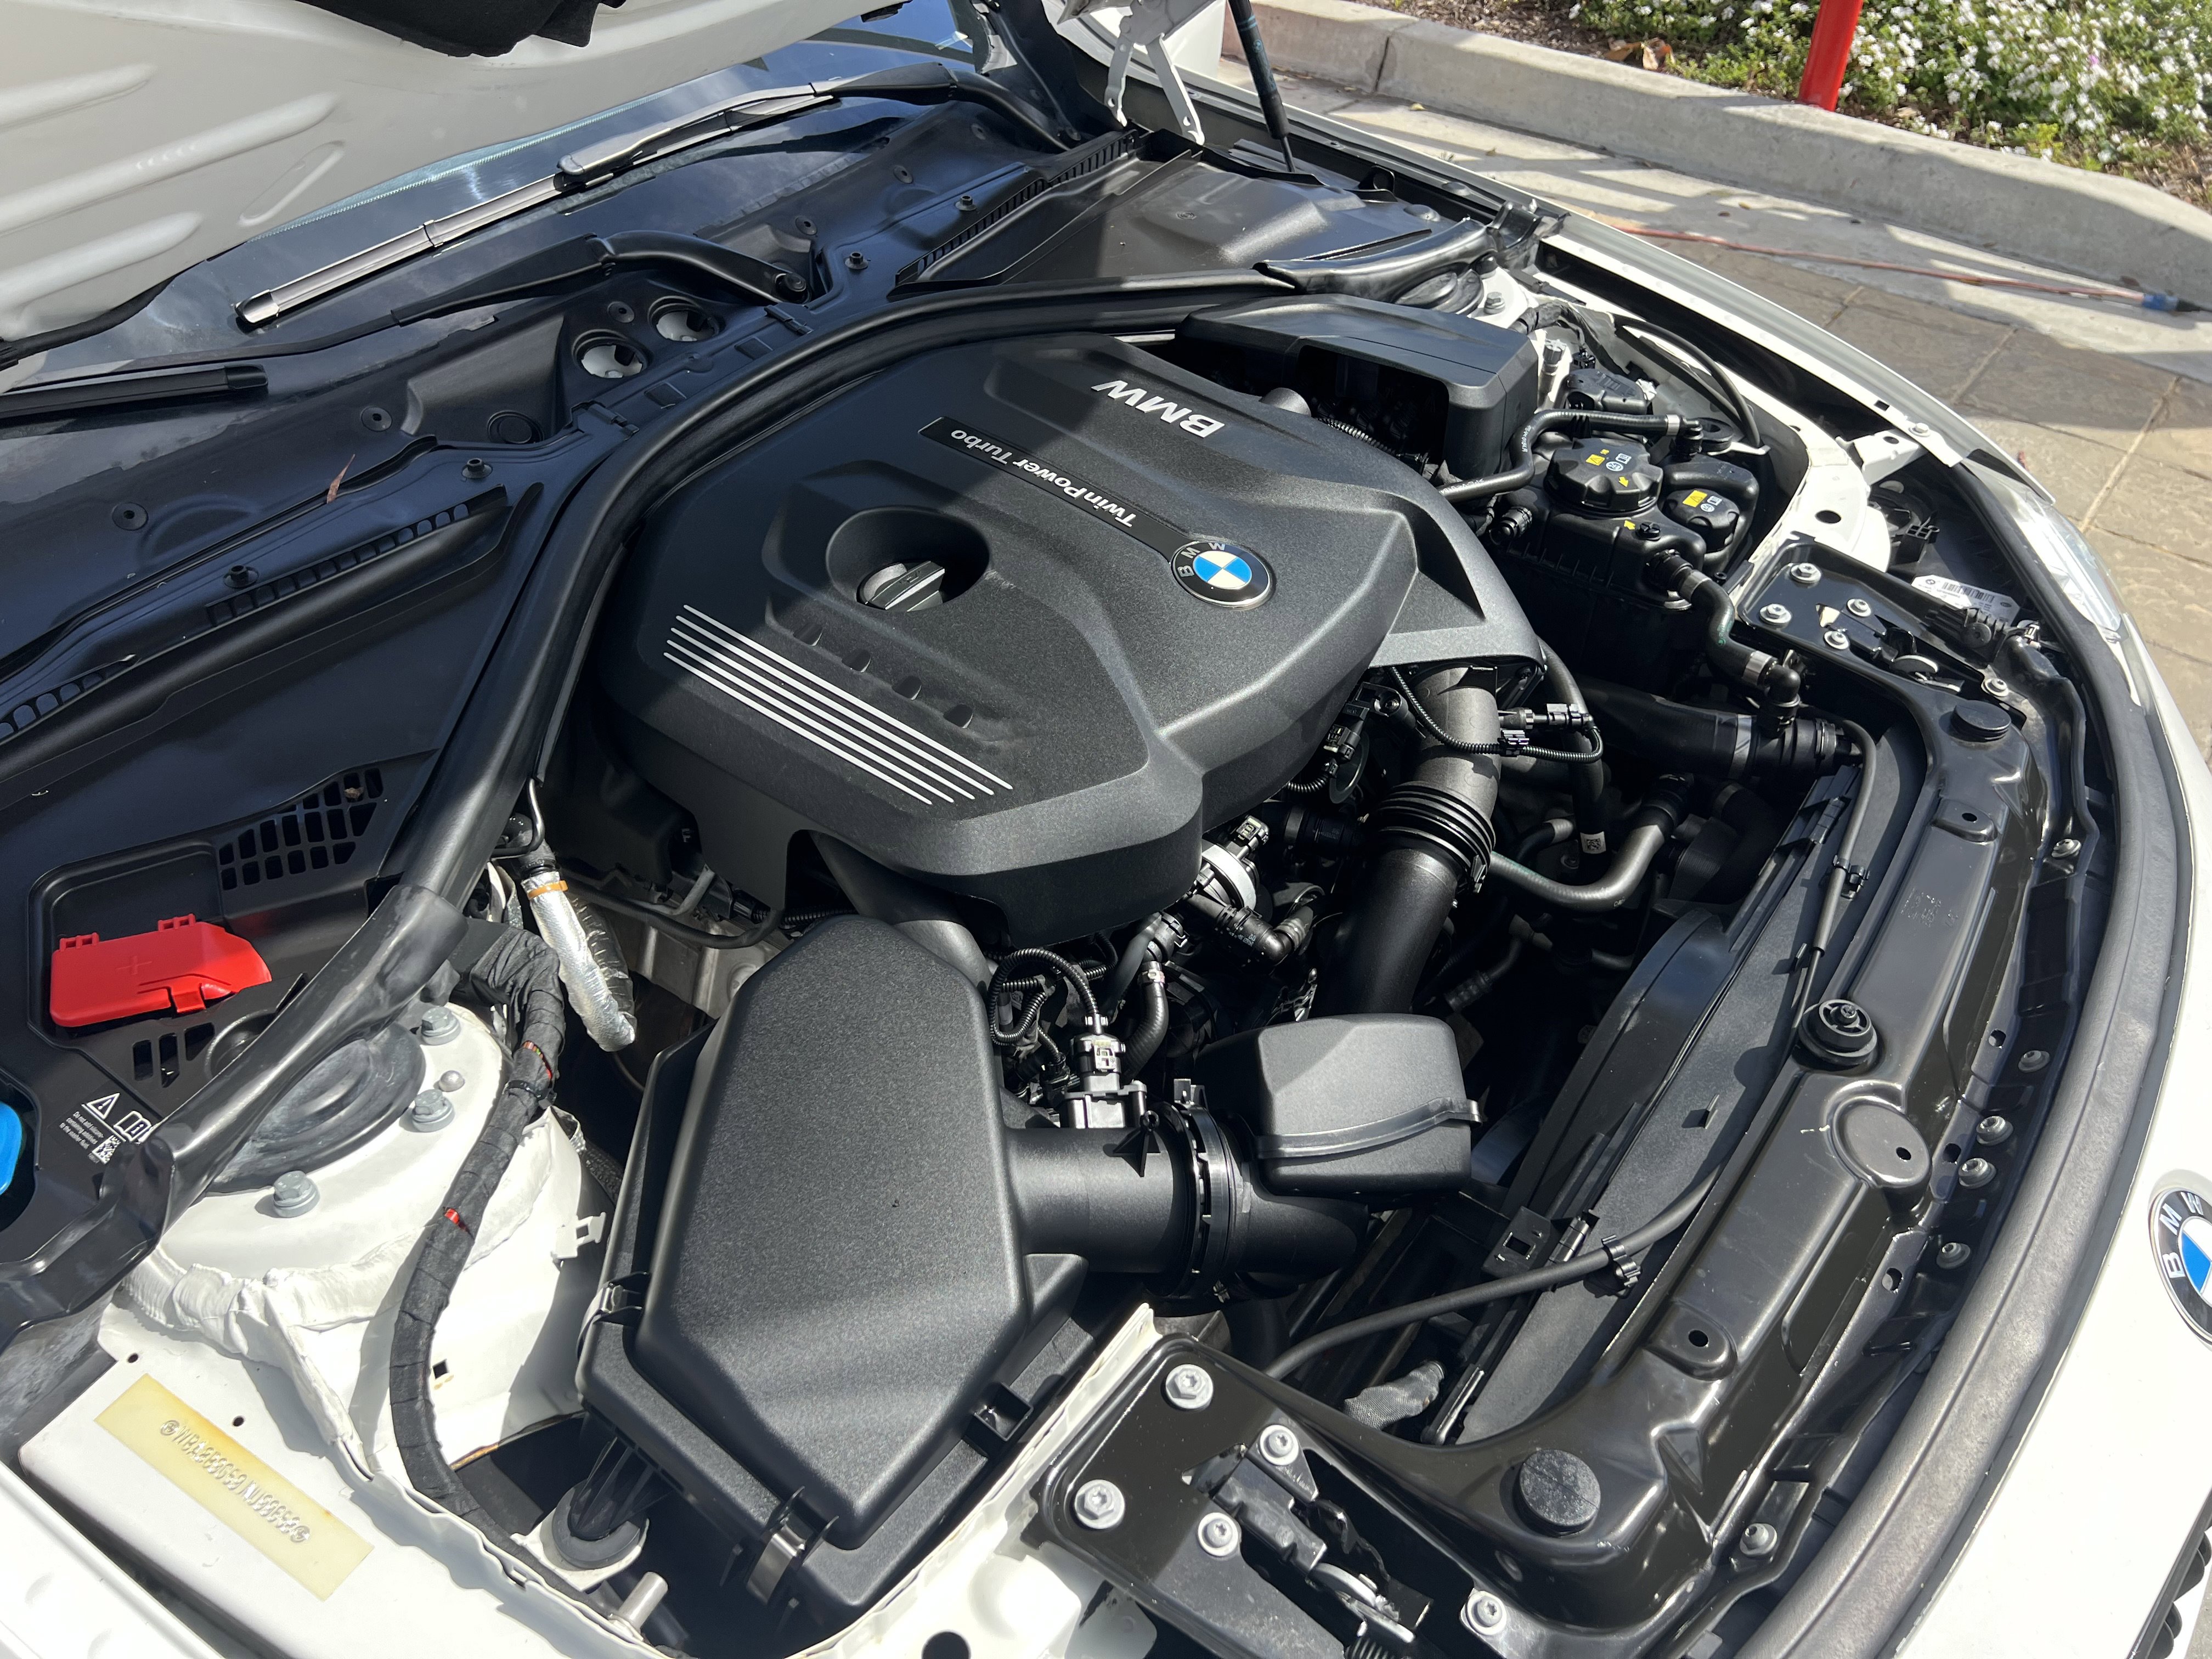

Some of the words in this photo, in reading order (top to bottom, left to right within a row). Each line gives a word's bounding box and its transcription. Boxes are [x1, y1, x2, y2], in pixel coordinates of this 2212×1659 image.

[1091, 380, 1226, 438] BMW
[951, 429, 1012, 465] Turbo
[1013, 457, 1136, 528] TwinPower
[1177, 541, 1226, 578] BMW
[2159, 1192, 2204, 1279] BMW
